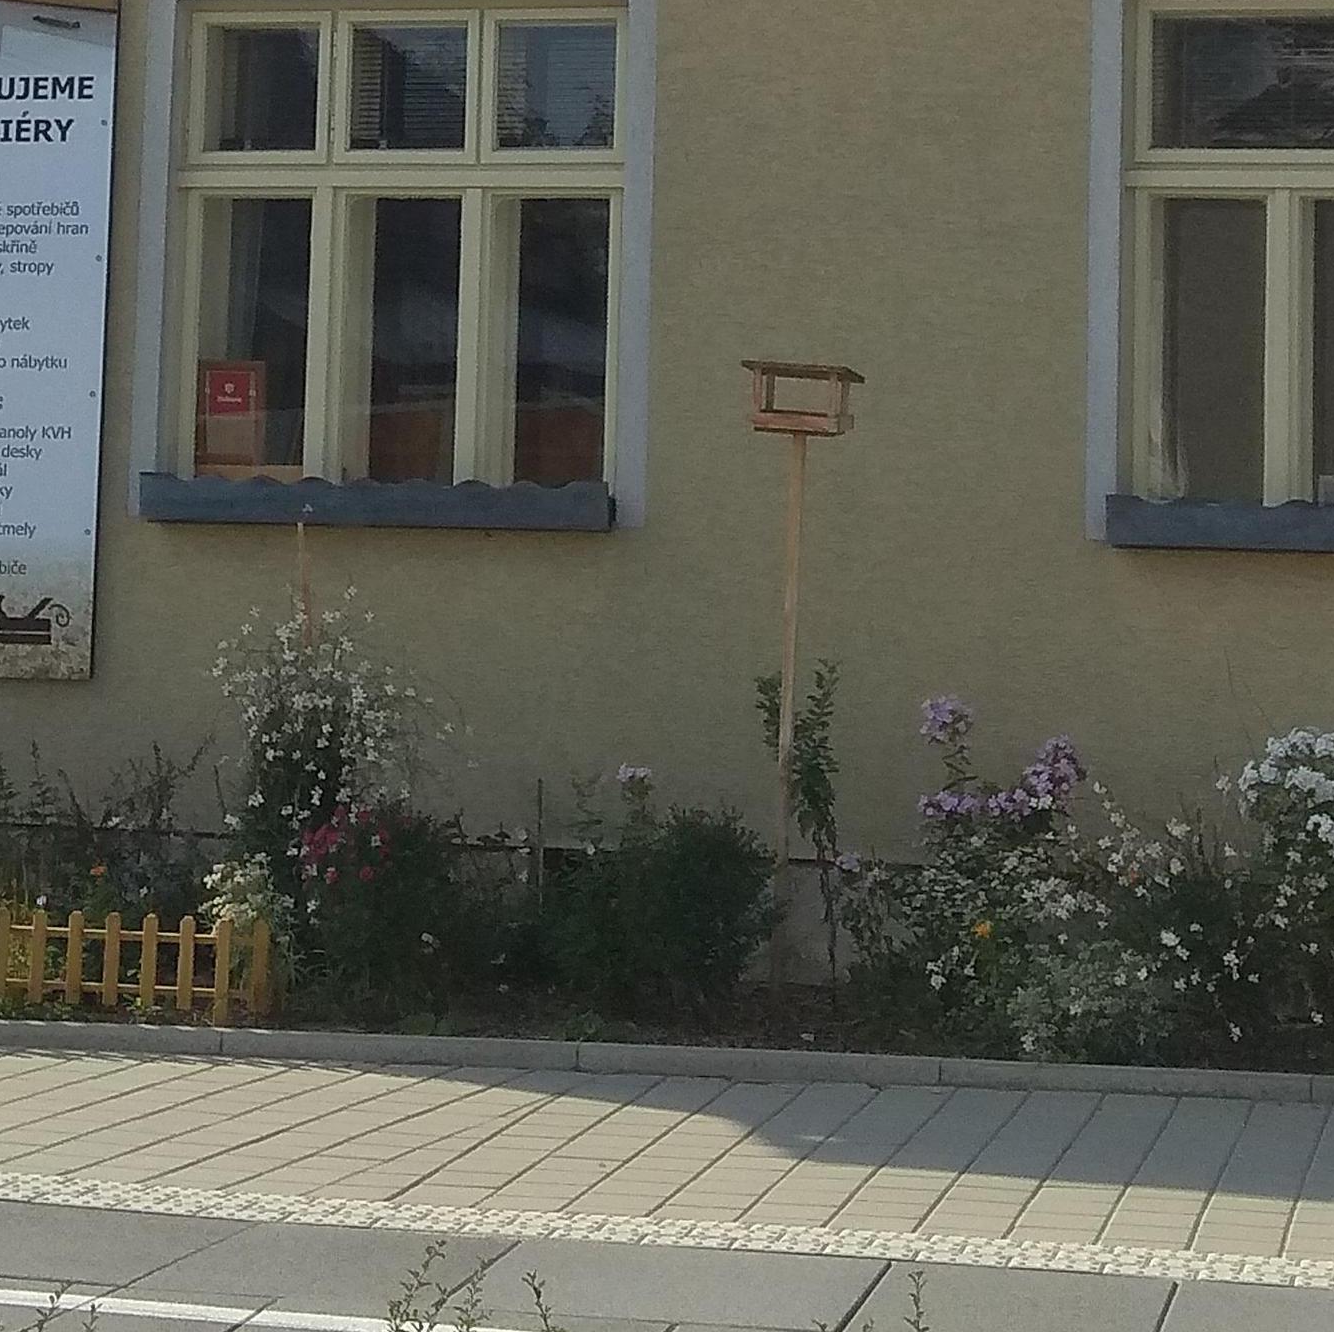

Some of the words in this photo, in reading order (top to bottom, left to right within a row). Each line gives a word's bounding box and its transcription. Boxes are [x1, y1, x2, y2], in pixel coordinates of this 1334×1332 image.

[7, 202, 79, 217] spotřebičů
[57, 222, 88, 235] hran
[9, 261, 54, 275] stropy
[11, 355, 67, 371] nábytku
[41, 427, 72, 439] KVH
[1, 446, 42, 460] desky
